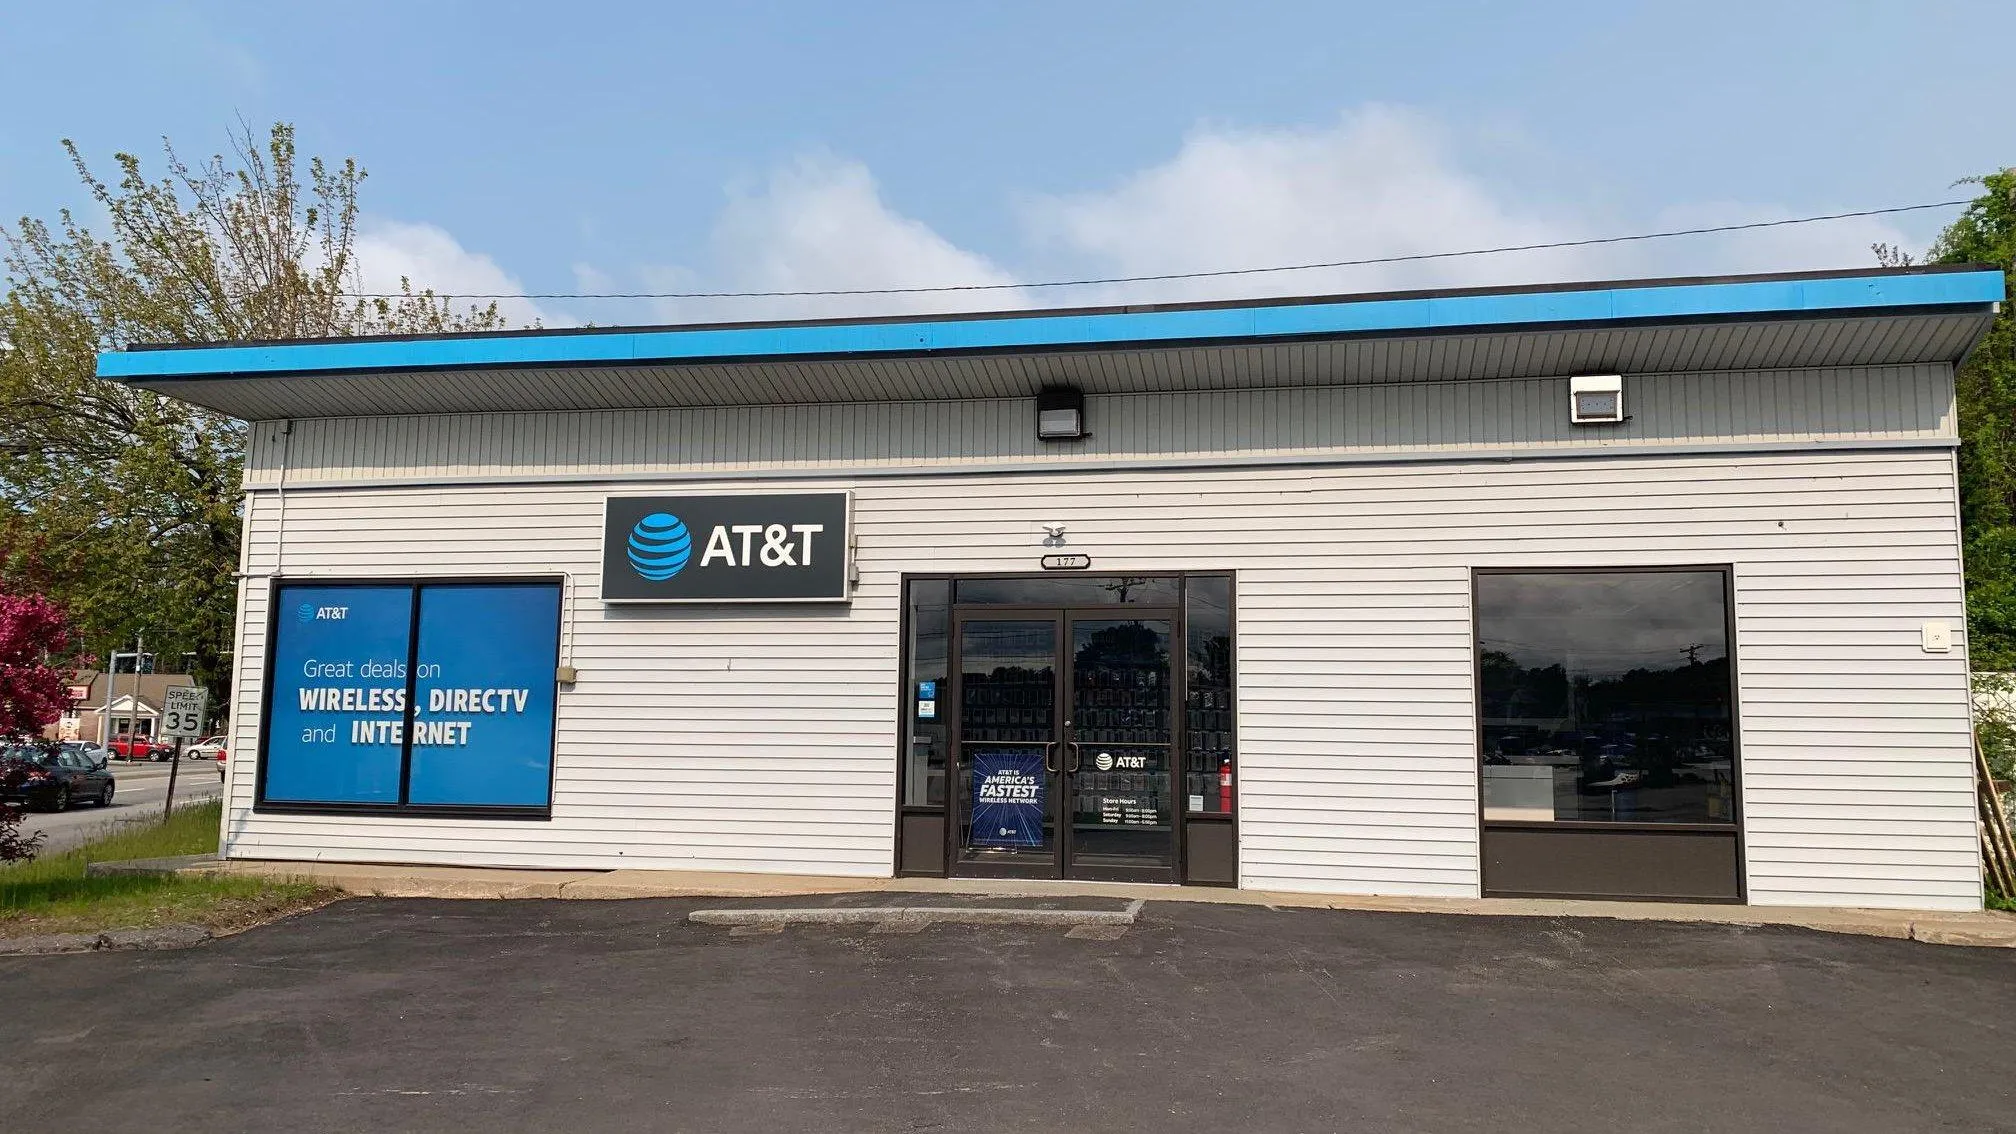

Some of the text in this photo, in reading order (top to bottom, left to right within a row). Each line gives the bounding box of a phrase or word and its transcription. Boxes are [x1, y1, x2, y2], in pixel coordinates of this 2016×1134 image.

[700, 524, 824, 567] AT&T
[1056, 557, 1076, 566] 177
[316, 607, 348, 620] AT&T
[303, 659, 440, 678] Great deals on
[170, 701, 199, 711] LIMIT
[429, 688, 529, 713] DIRECTV
[165, 711, 199, 731] 35
[301, 720, 472, 745] and INTERNET
[1116, 756, 1146, 768] AT&T
[984, 775, 1035, 784] AMERICA'S
[980, 785, 1039, 797] FASTEST
